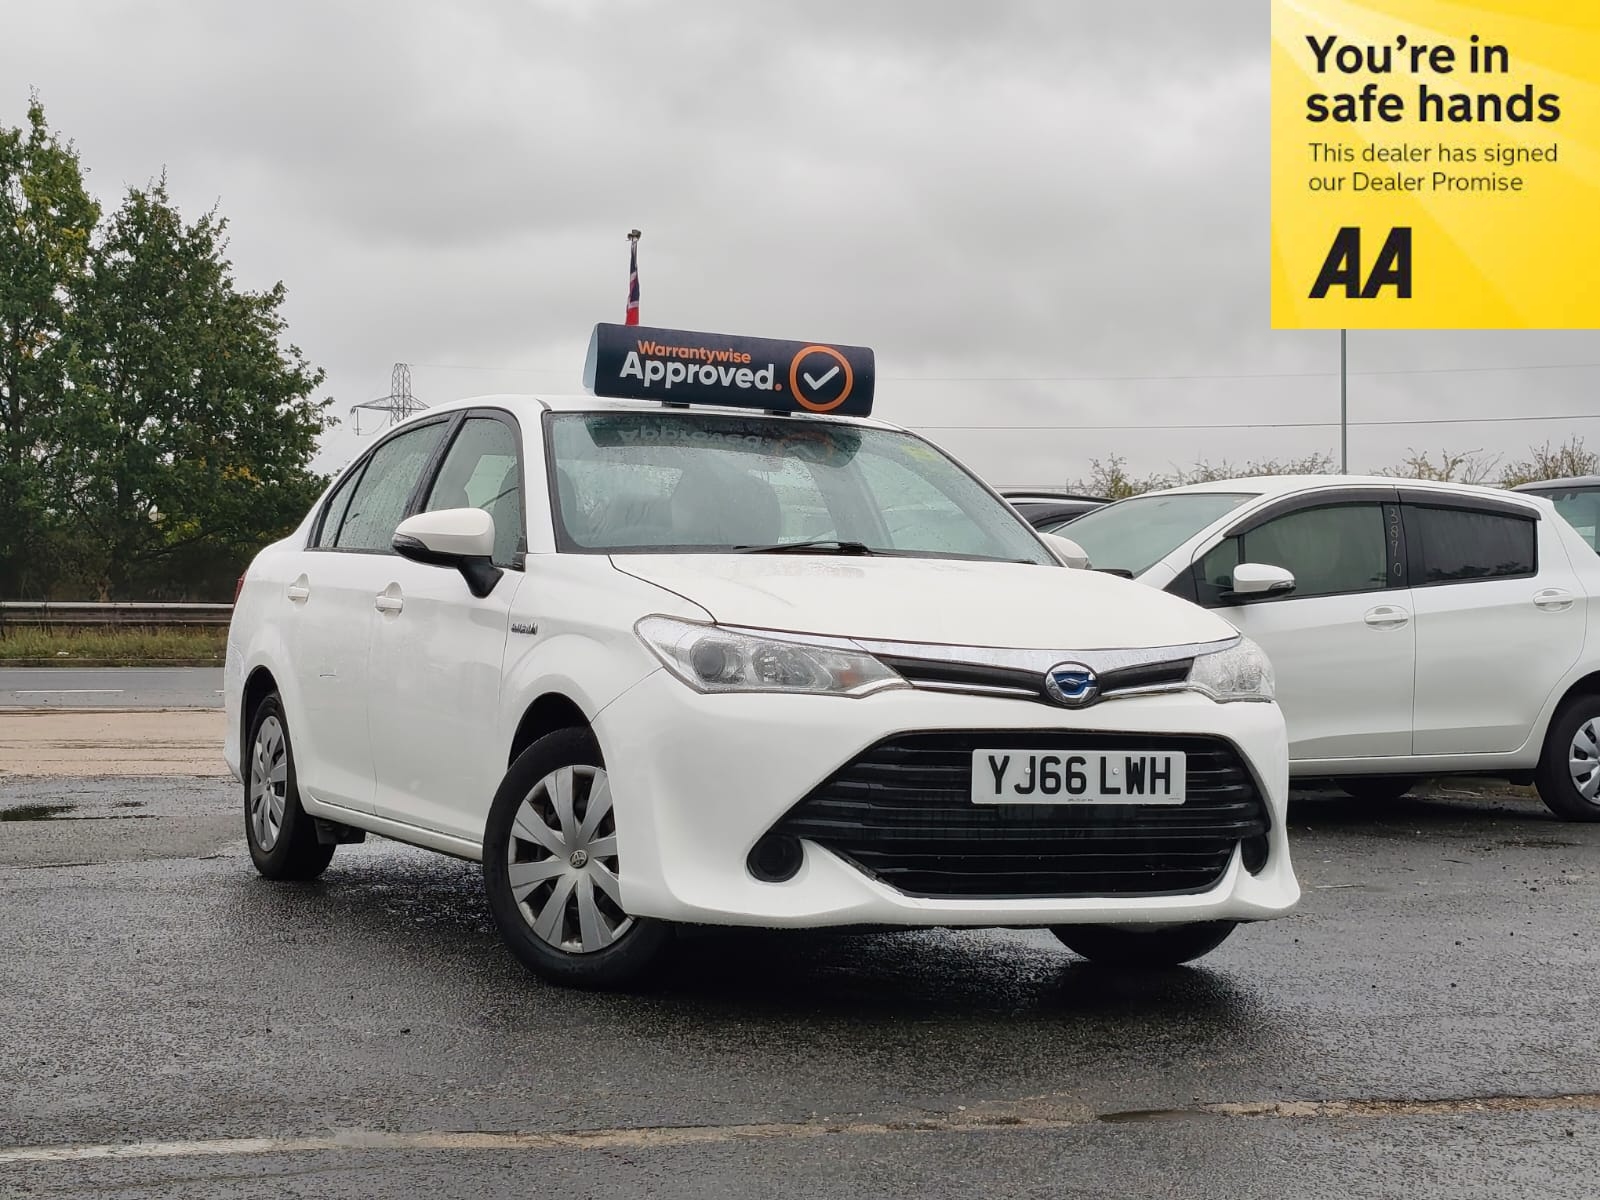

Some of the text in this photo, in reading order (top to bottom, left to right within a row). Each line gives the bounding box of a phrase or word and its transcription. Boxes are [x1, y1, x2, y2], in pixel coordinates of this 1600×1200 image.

[619, 350, 783, 392] Approved.
[637, 340, 752, 364] Warrantywise
[988, 755, 1171, 795] YJ66 LWH
